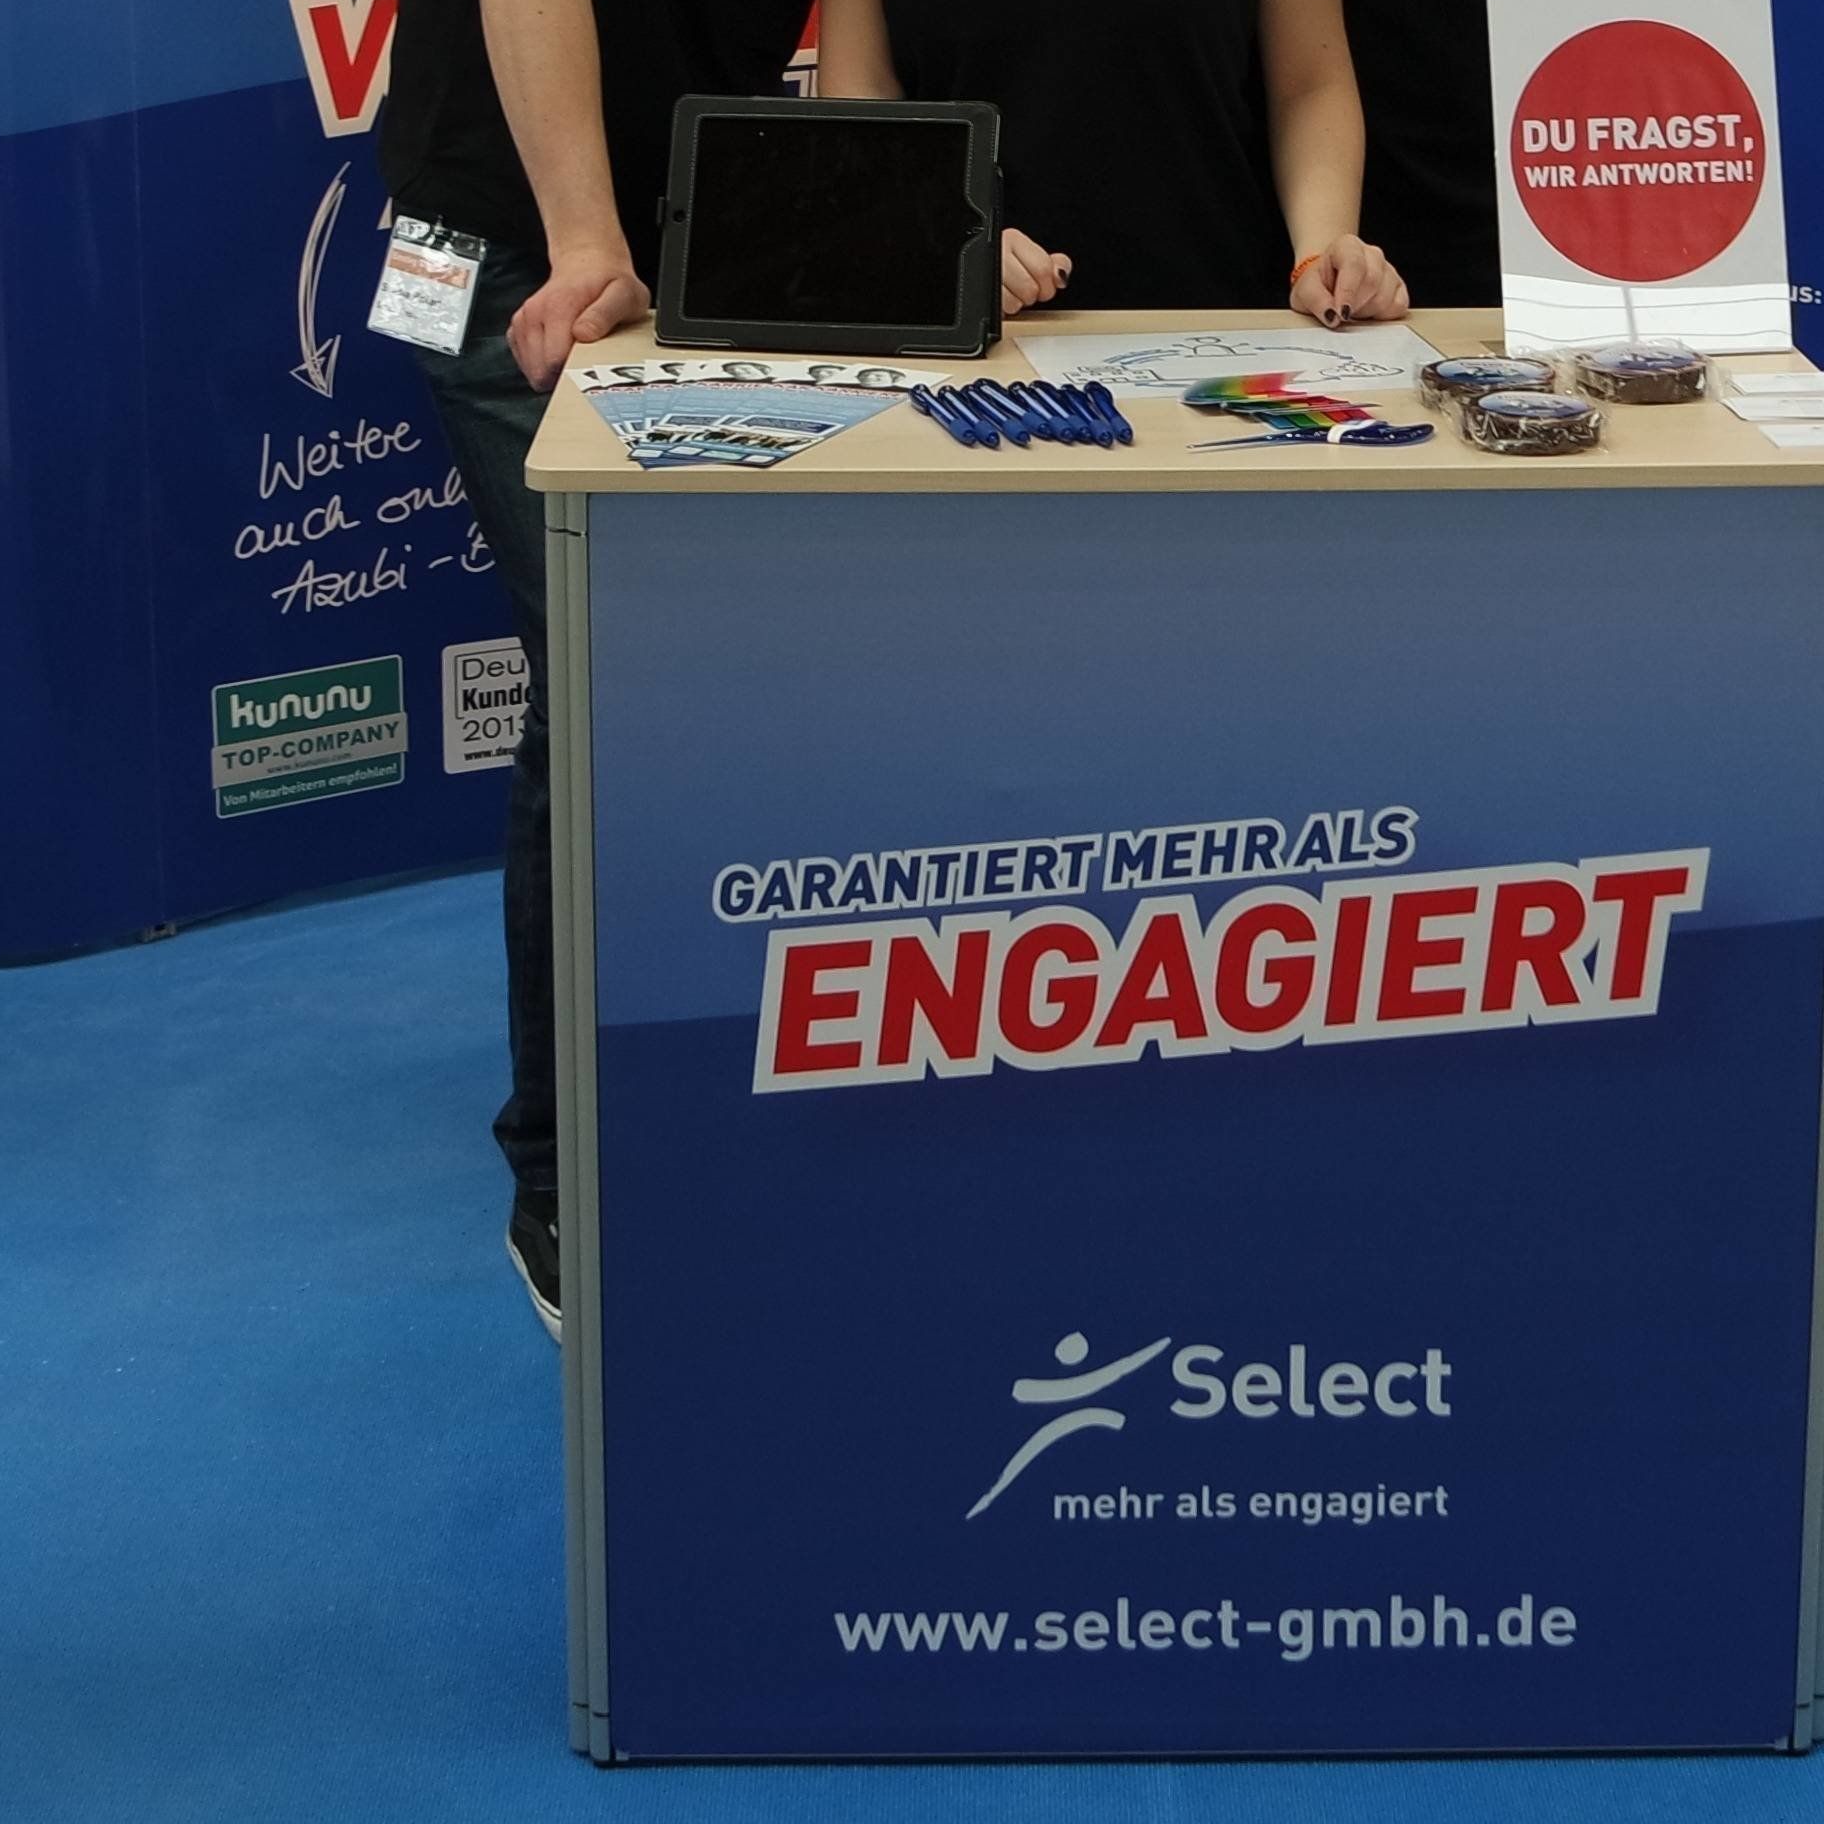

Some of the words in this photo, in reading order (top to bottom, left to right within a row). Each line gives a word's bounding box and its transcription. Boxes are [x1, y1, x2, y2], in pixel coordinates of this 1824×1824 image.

[1520, 119, 1576, 154] DU
[1587, 113, 1756, 155] FRAGST,
[1523, 164, 1577, 189] WIR
[1581, 159, 1755, 188] ANTWORTEN!
[259, 418, 423, 500] Weitere
[233, 494, 361, 560] auch
[230, 684, 372, 729] kununu
[221, 720, 400, 771] TOP-COMPANY
[223, 794, 248, 807] Von
[249, 778, 326, 802] Mitarbeitern
[327, 762, 398, 787] empfohlen!
[716, 838, 1096, 918] GARANTIERT
[1107, 822, 1281, 884] MEHR
[1291, 808, 1413, 867] ALS
[766, 860, 1698, 1080] ENGAGIERT
[1169, 1343, 1452, 1419] Select
[1052, 1486, 1164, 1520] mehr
[1175, 1485, 1237, 1519] als
[1248, 1483, 1450, 1526] engagiert
[833, 1594, 1577, 1662] www.select-gmbh.de
